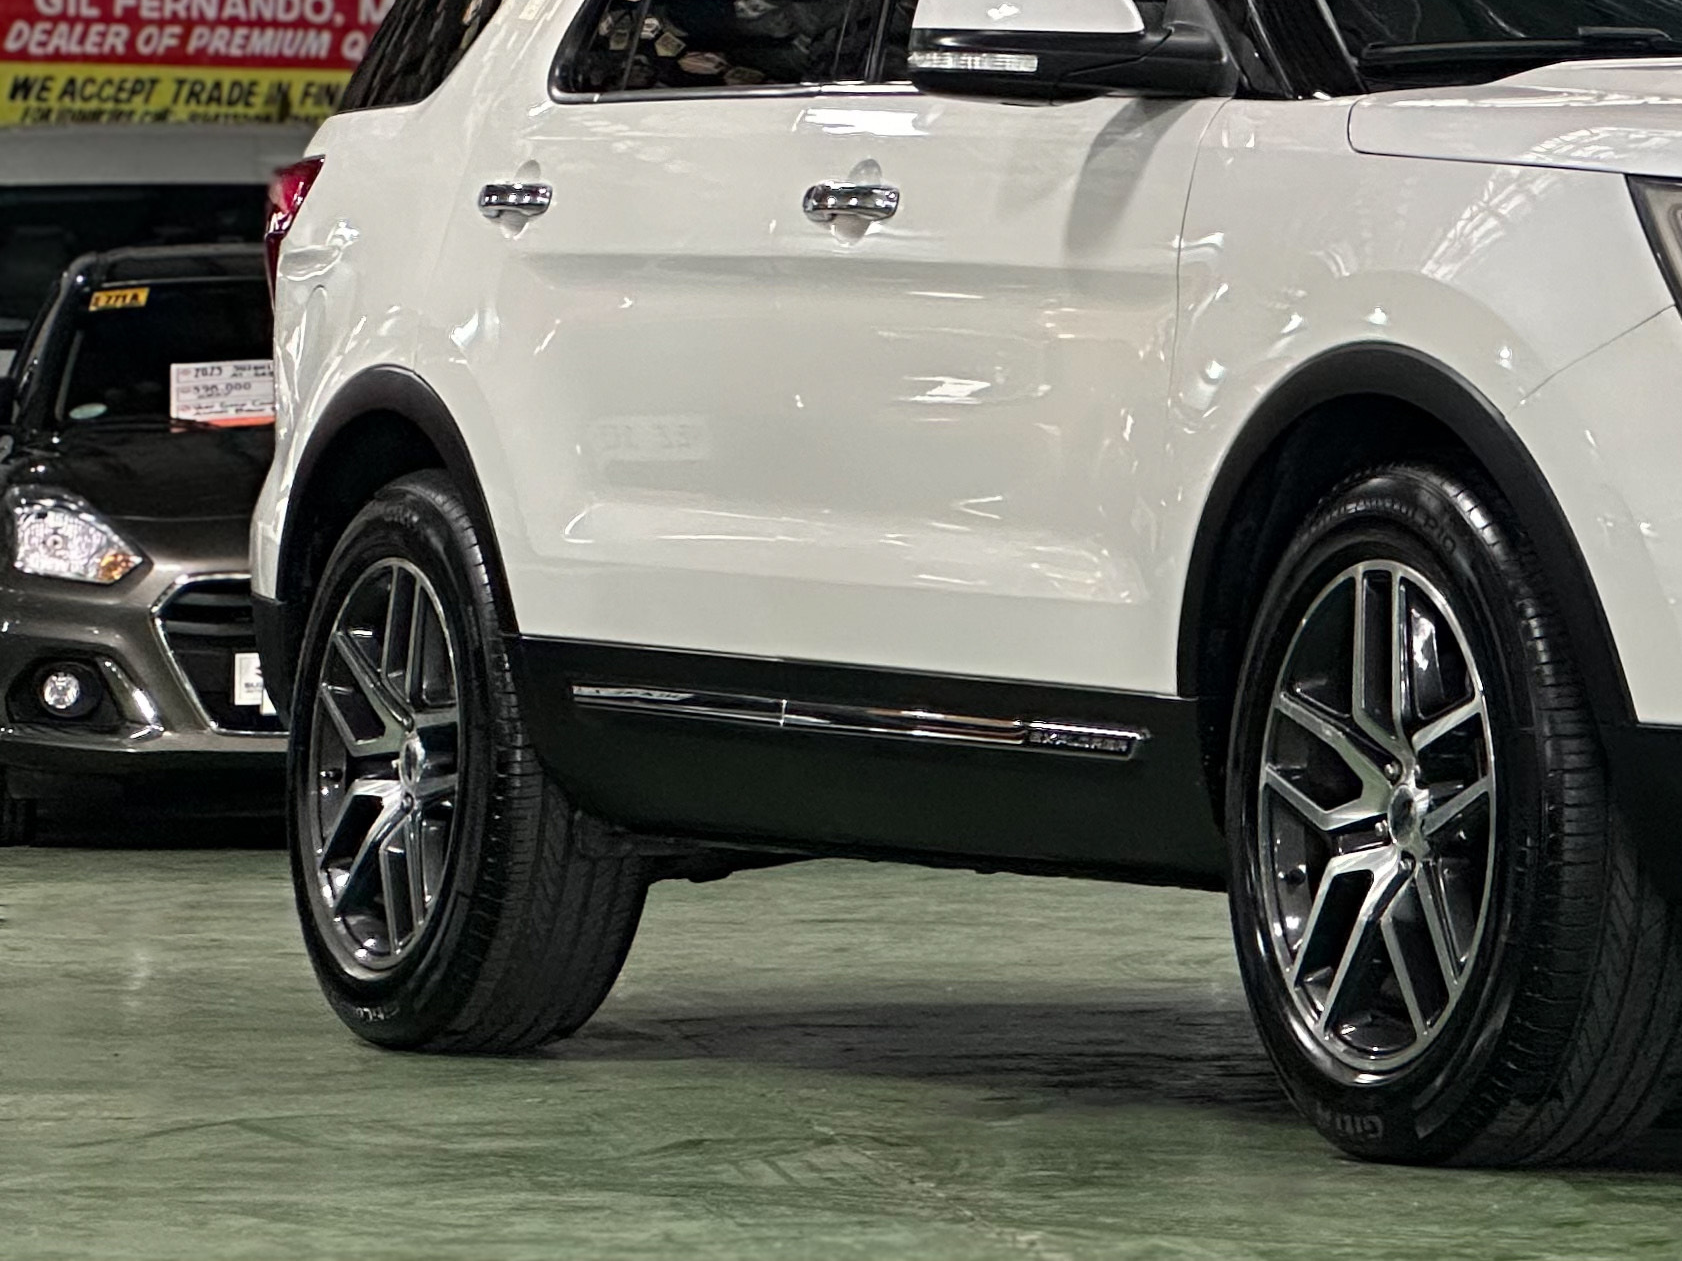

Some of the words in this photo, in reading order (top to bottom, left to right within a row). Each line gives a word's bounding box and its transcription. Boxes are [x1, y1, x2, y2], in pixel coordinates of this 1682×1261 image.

[5, 19, 129, 56] DEALER
[136, 24, 183, 55] OF
[187, 27, 331, 59] PREMIUM
[9, 75, 54, 102] WE
[59, 77, 159, 105] ACCEPT
[173, 78, 258, 106] TRADE
